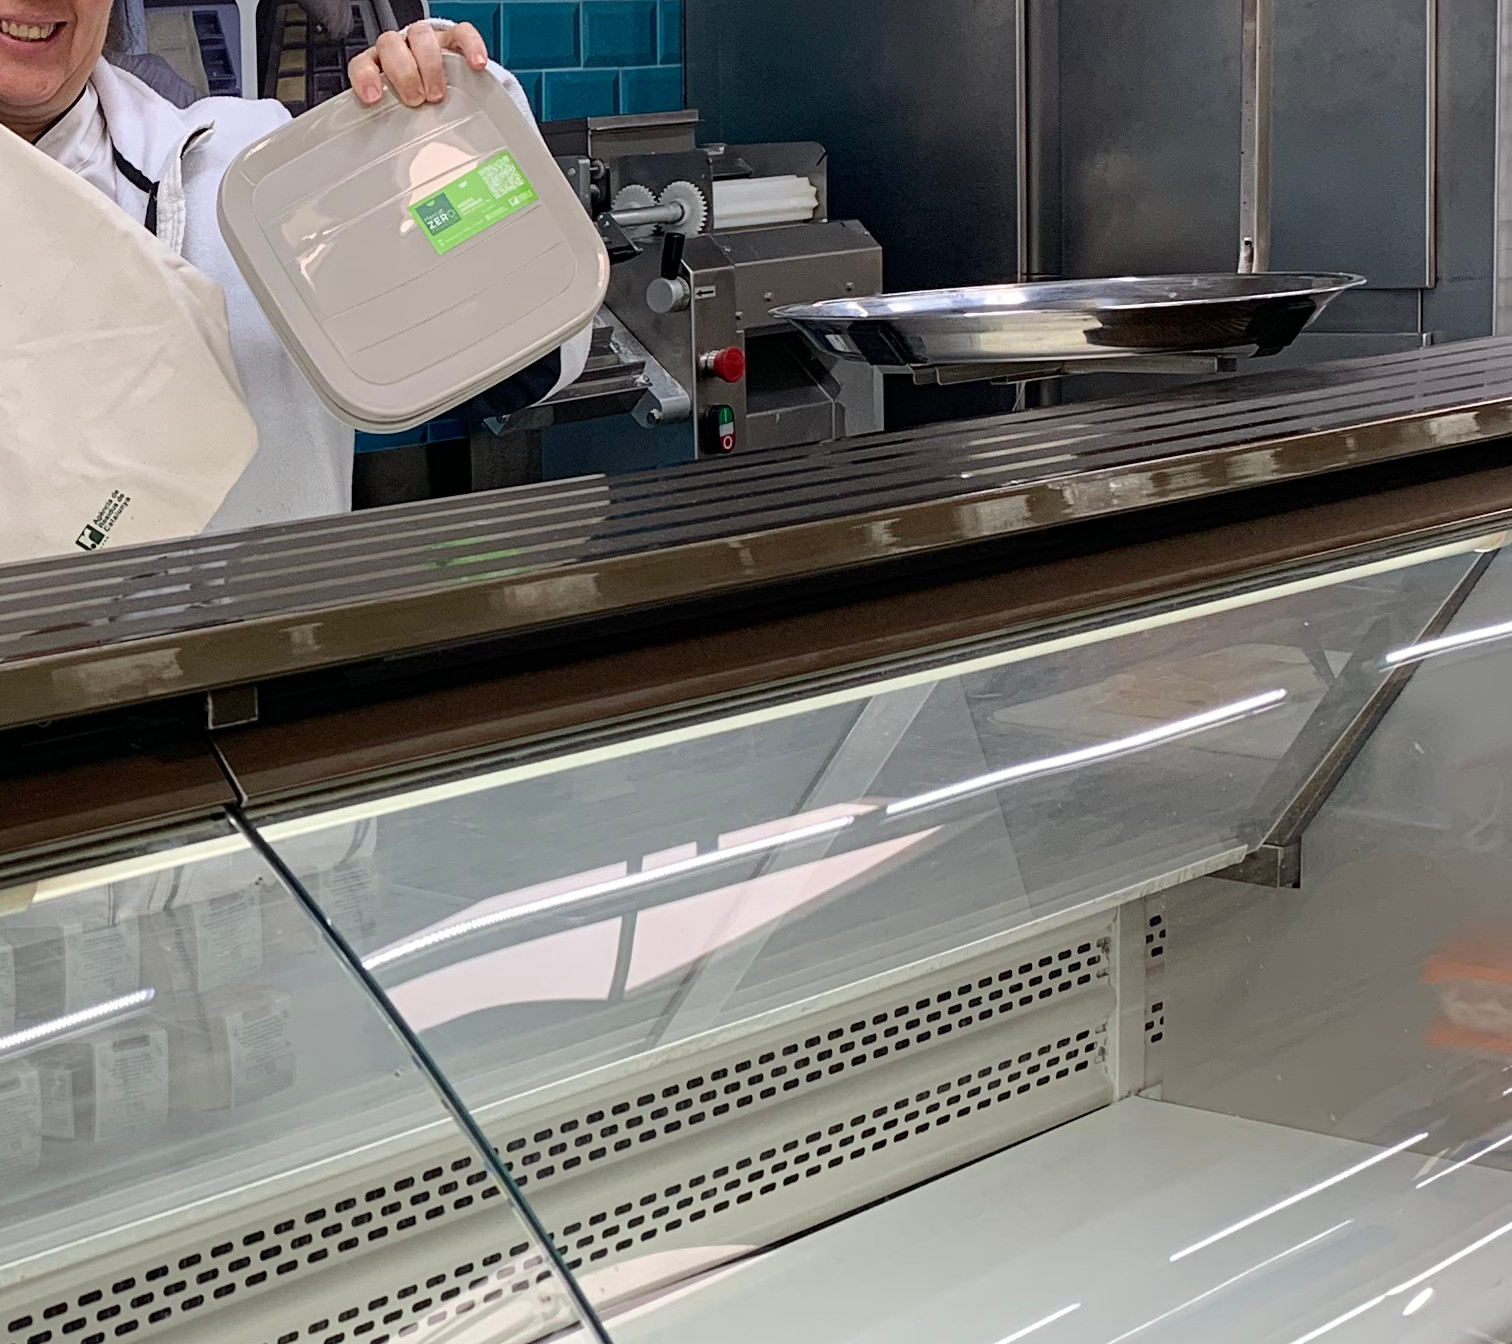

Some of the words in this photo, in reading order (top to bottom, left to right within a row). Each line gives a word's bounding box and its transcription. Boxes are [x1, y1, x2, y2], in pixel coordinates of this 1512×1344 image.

[98, 503, 119, 528] Residus
[117, 493, 125, 502] de
[112, 489, 120, 499] de
[104, 497, 131, 532] Catalunya
